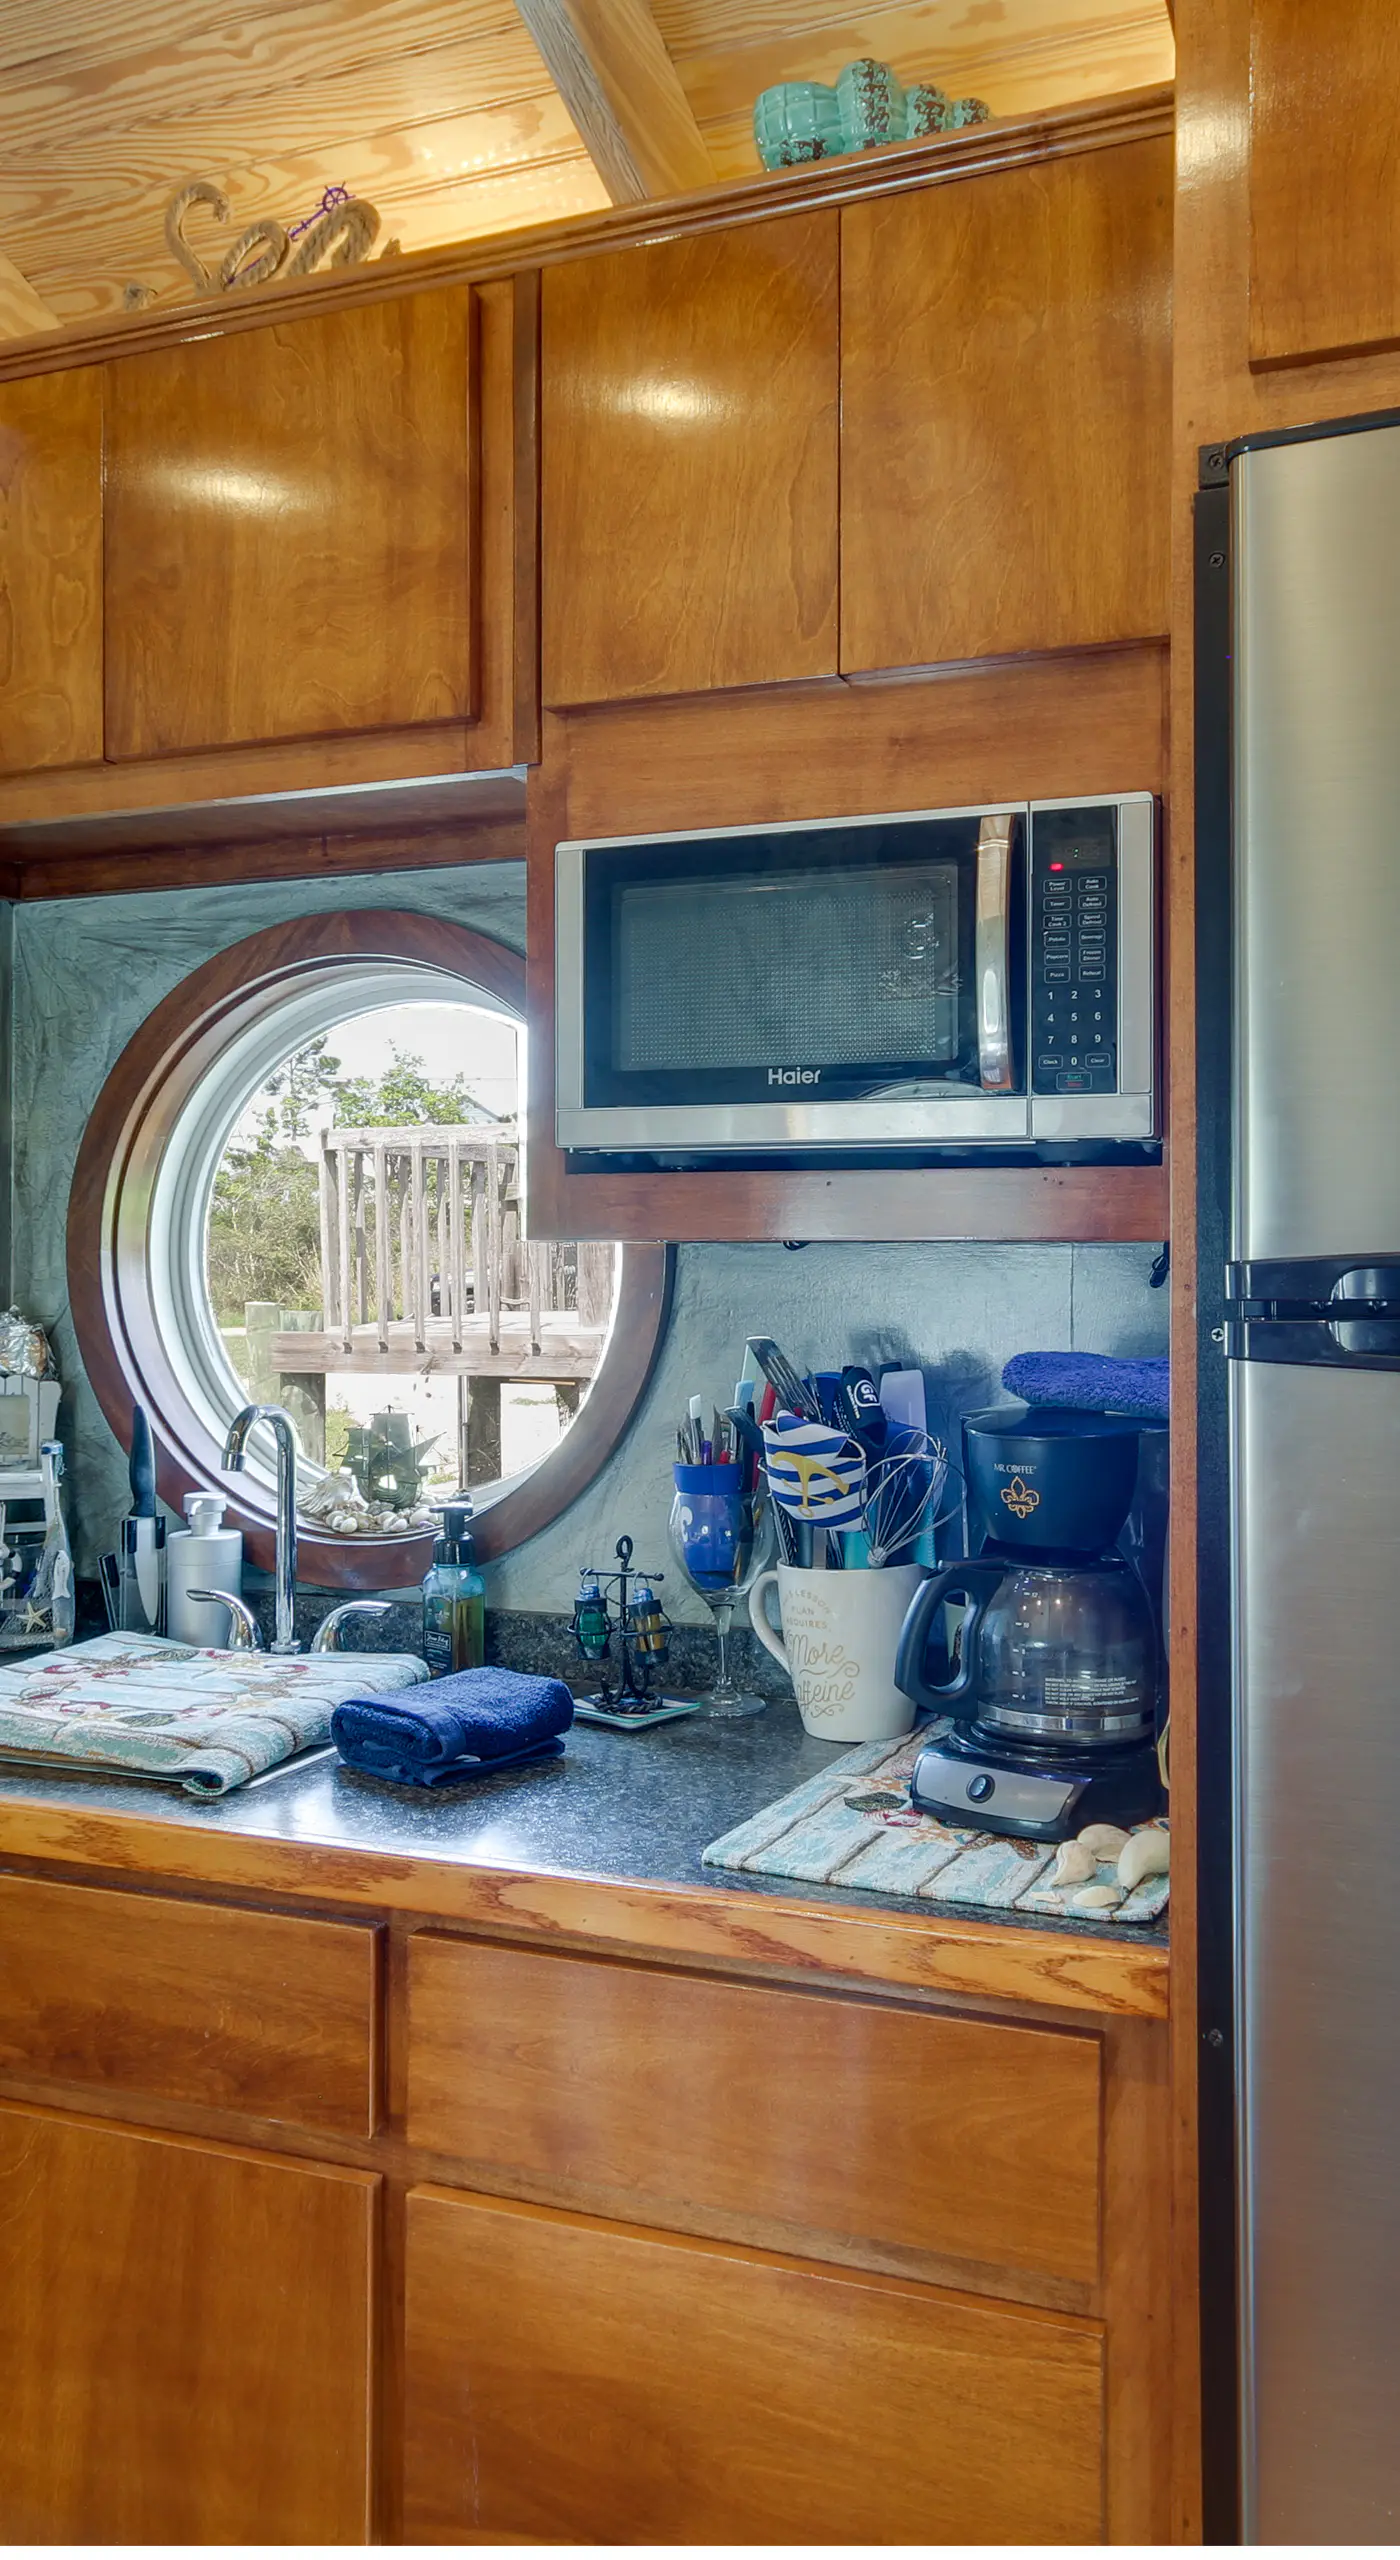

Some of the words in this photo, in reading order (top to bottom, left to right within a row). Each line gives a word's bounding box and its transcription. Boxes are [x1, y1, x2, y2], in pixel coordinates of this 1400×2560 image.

[1047, 991, 1053, 1000] 1
[1071, 990, 1078, 999] 2
[1094, 989, 1101, 998] 3
[1047, 1013, 1054, 1022] 4
[1071, 1012, 1078, 1021] 5
[1094, 1011, 1101, 1020] 6
[1047, 1035, 1054, 1044] 7
[1071, 1034, 1078, 1043] 8
[1094, 1034, 1101, 1043] 9
[1071, 1056, 1077, 1065] 0
[768, 1066, 821, 1085] Haier
[860, 1384, 877, 1402] GF
[786, 1632, 846, 1666] More
